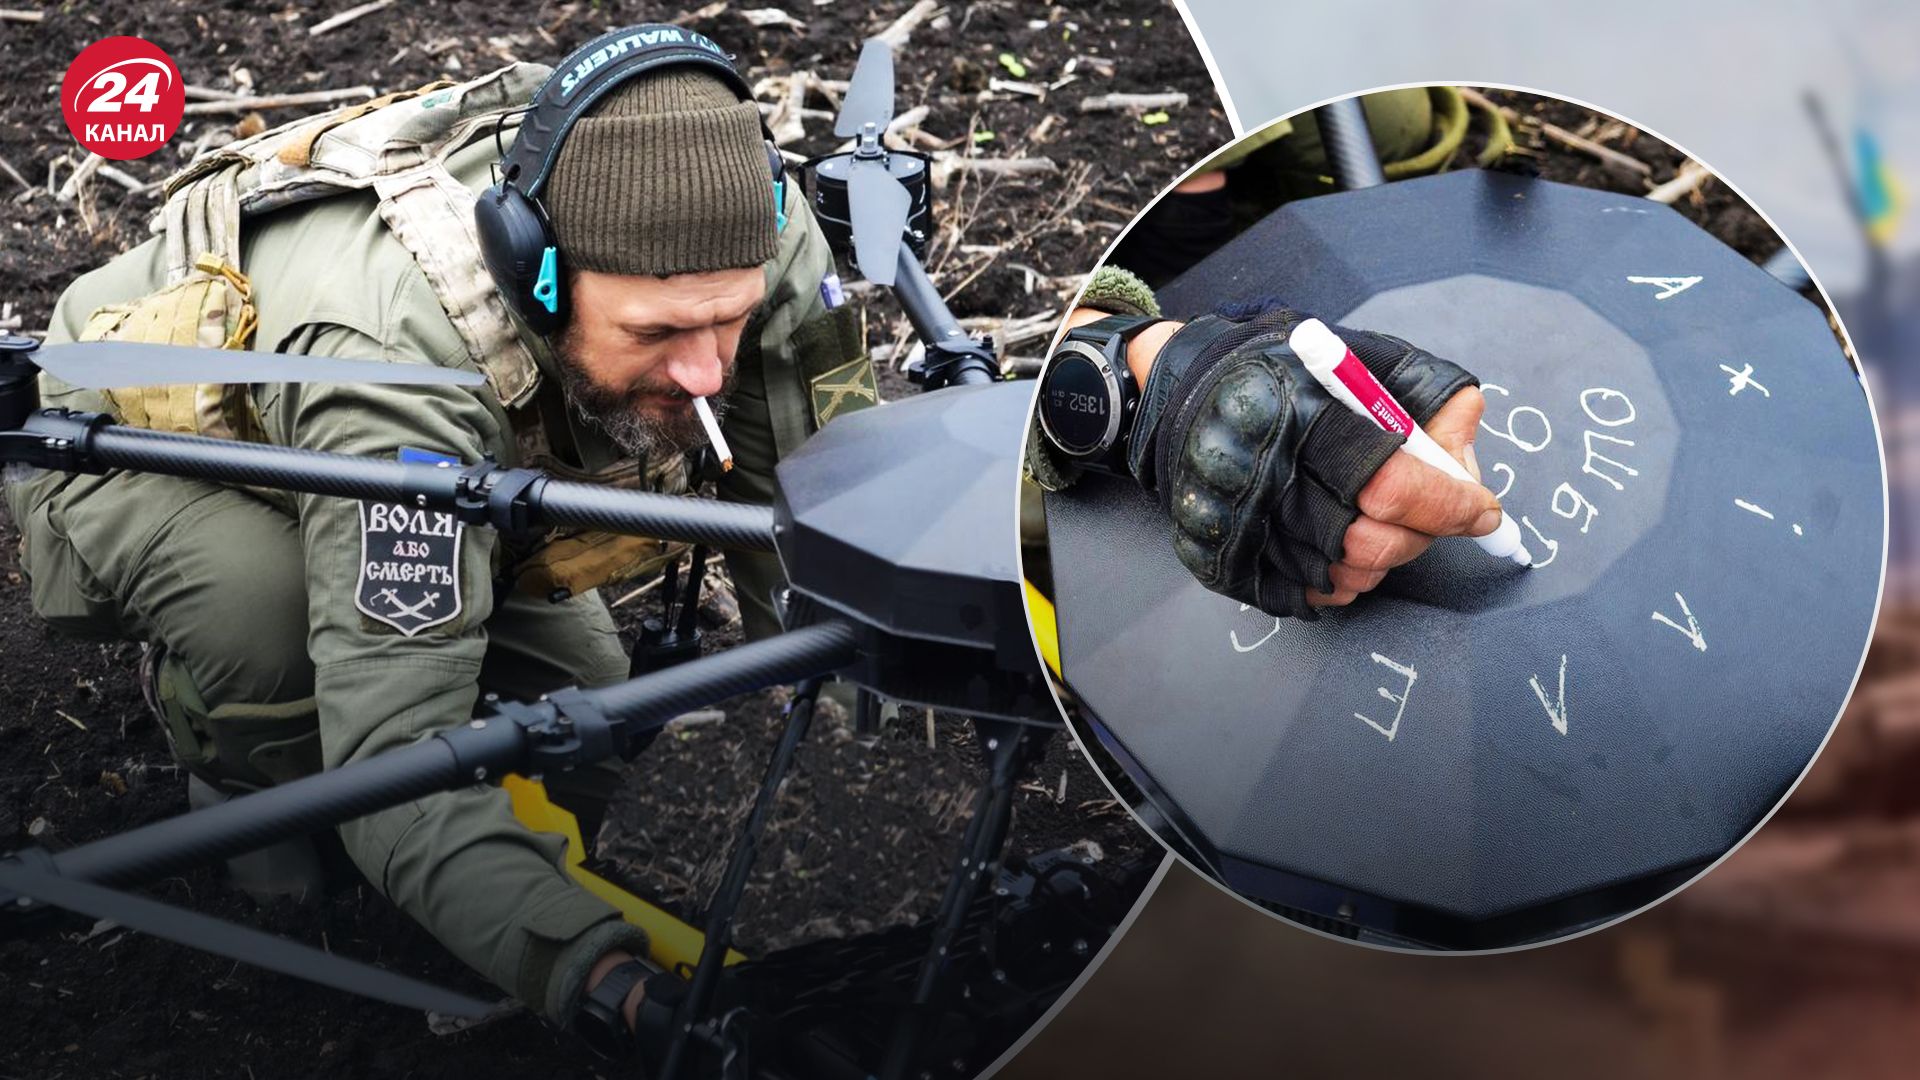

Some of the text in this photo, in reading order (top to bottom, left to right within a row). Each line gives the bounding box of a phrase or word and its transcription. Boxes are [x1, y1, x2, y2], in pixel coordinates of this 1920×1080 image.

[1069, 392, 1106, 416] 1352
[366, 503, 455, 538] ВОЛЯ
[392, 540, 430, 559] АБО
[366, 561, 453, 586] СМЕРТЬ
